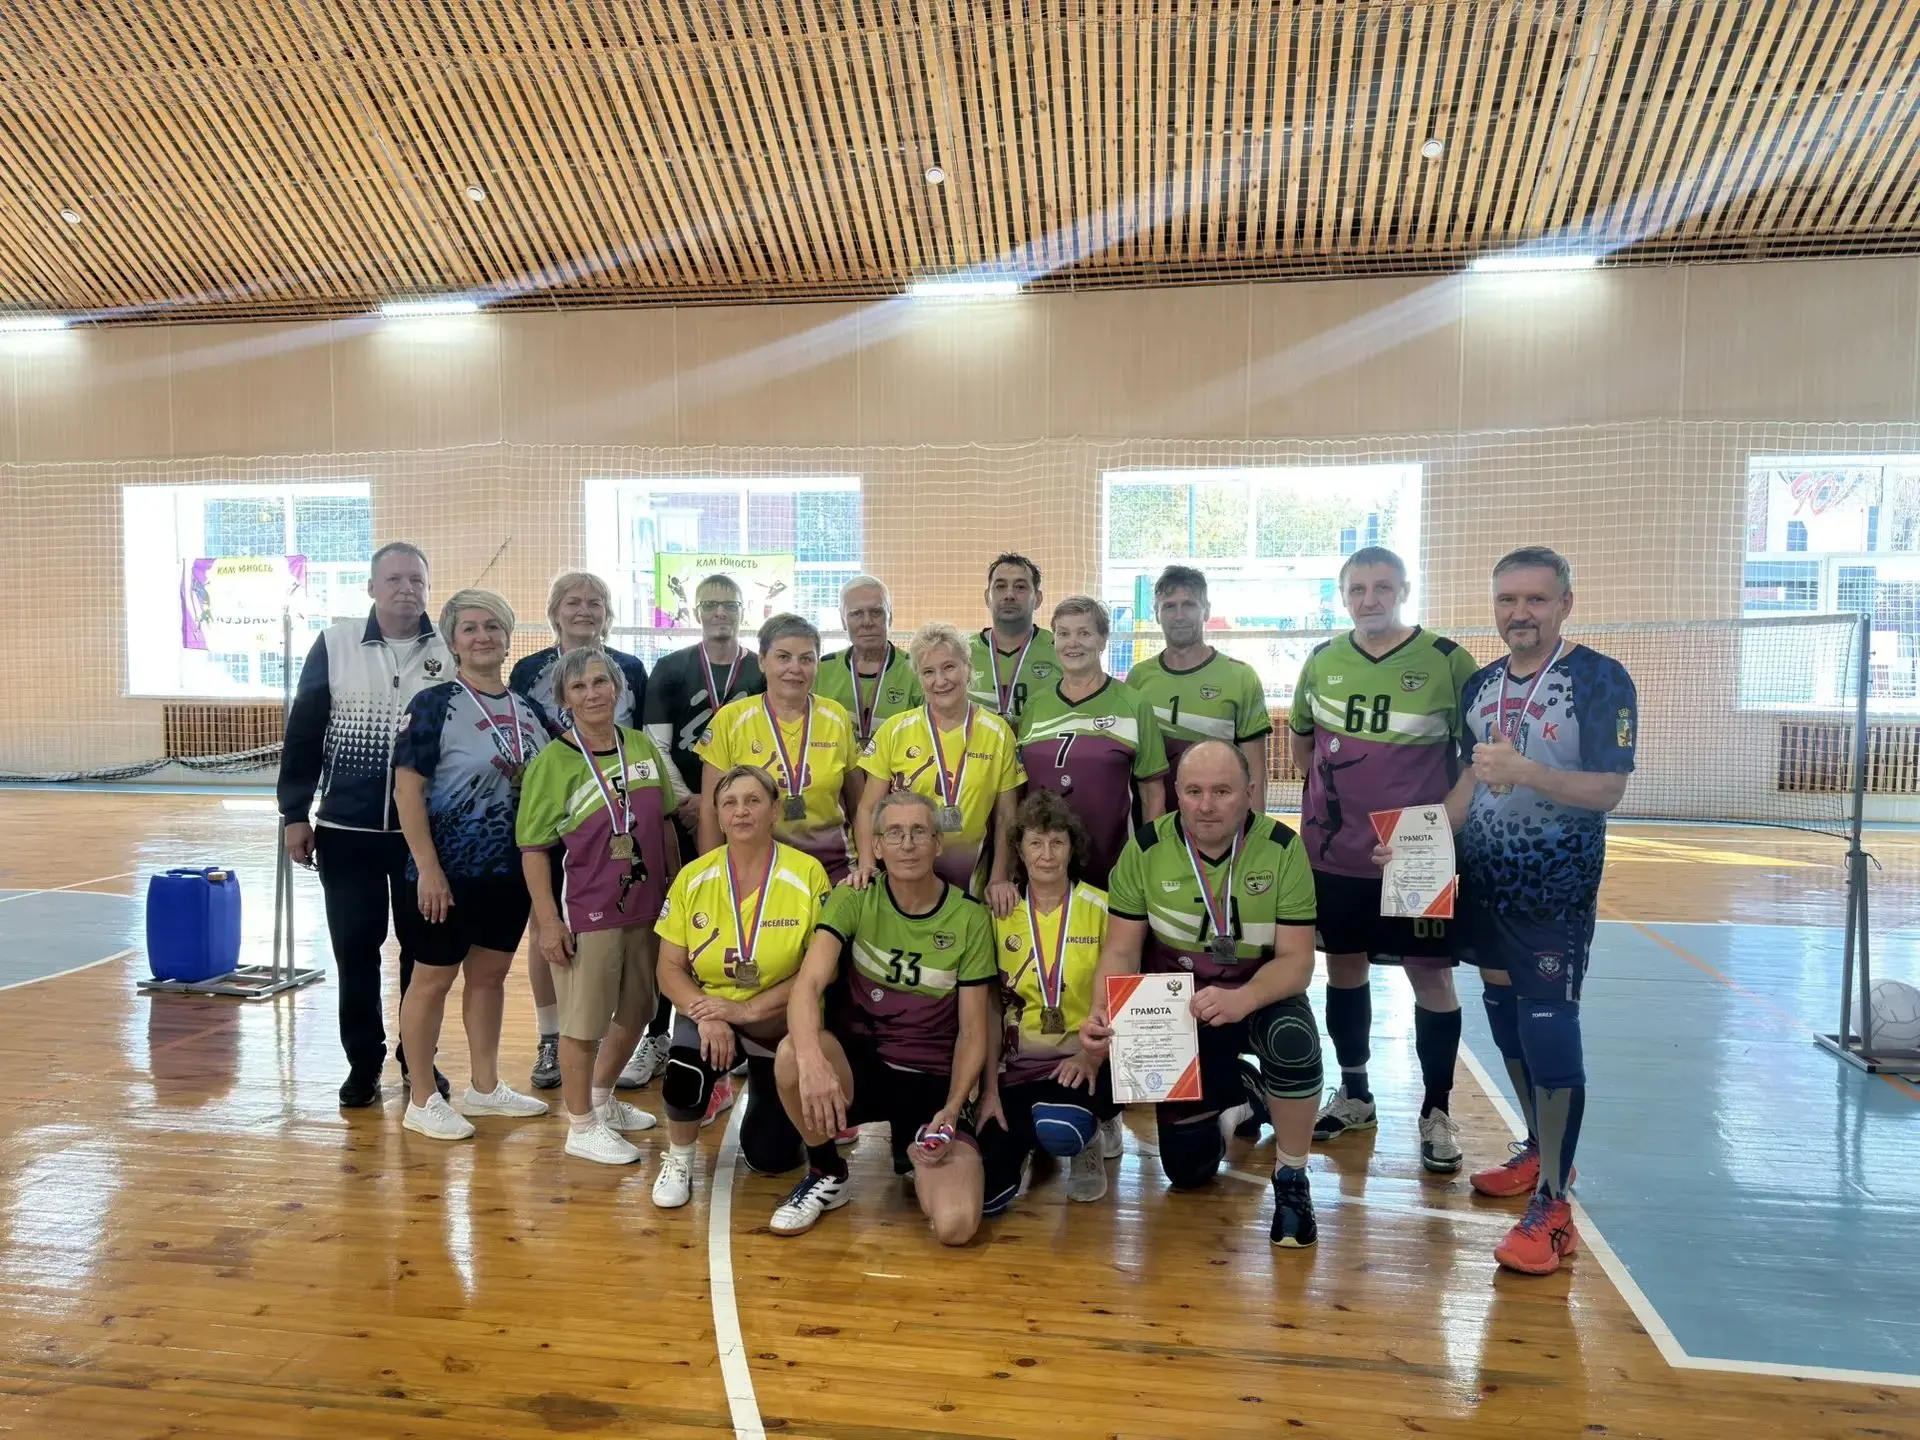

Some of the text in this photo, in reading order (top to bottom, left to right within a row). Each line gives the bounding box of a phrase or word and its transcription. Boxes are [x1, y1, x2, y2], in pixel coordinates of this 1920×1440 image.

[720, 556, 758, 569] ЮНОСТЬ
[1169, 695, 1180, 725] 1
[1345, 693, 1391, 734] 68
[1054, 731, 1076, 768] 7
[1398, 834, 1434, 842] ГРАМОТА
[885, 948, 923, 987] 33
[1130, 1007, 1172, 1016] ГРАМОТА
